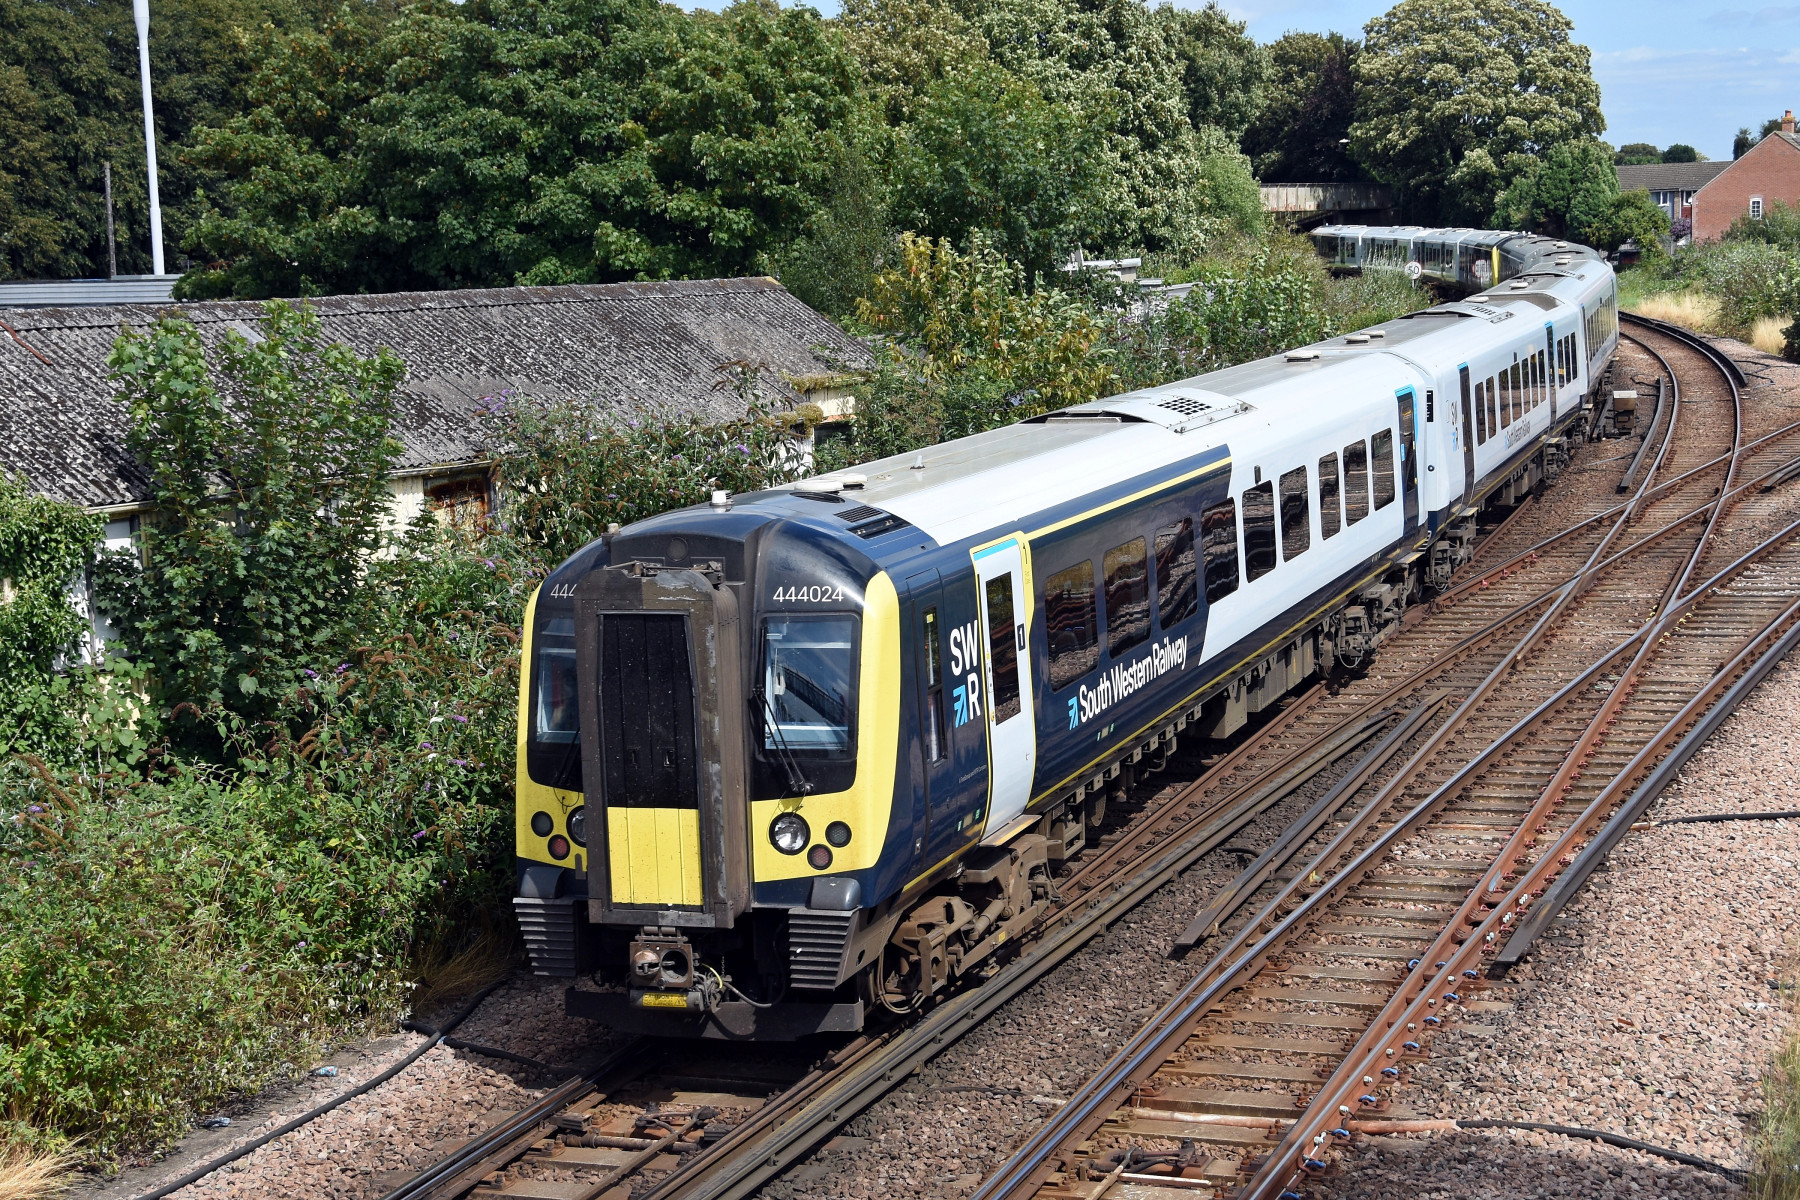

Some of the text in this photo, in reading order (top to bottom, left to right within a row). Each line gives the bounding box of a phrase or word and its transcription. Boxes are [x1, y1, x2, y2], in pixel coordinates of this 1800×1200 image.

[1407, 265, 1420, 275] 50
[772, 585, 844, 603] 444024
[949, 619, 978, 677] SW
[1018, 627, 1024, 647] 1
[967, 672, 981, 720] R
[1079, 635, 1188, 723] South Western Railway
